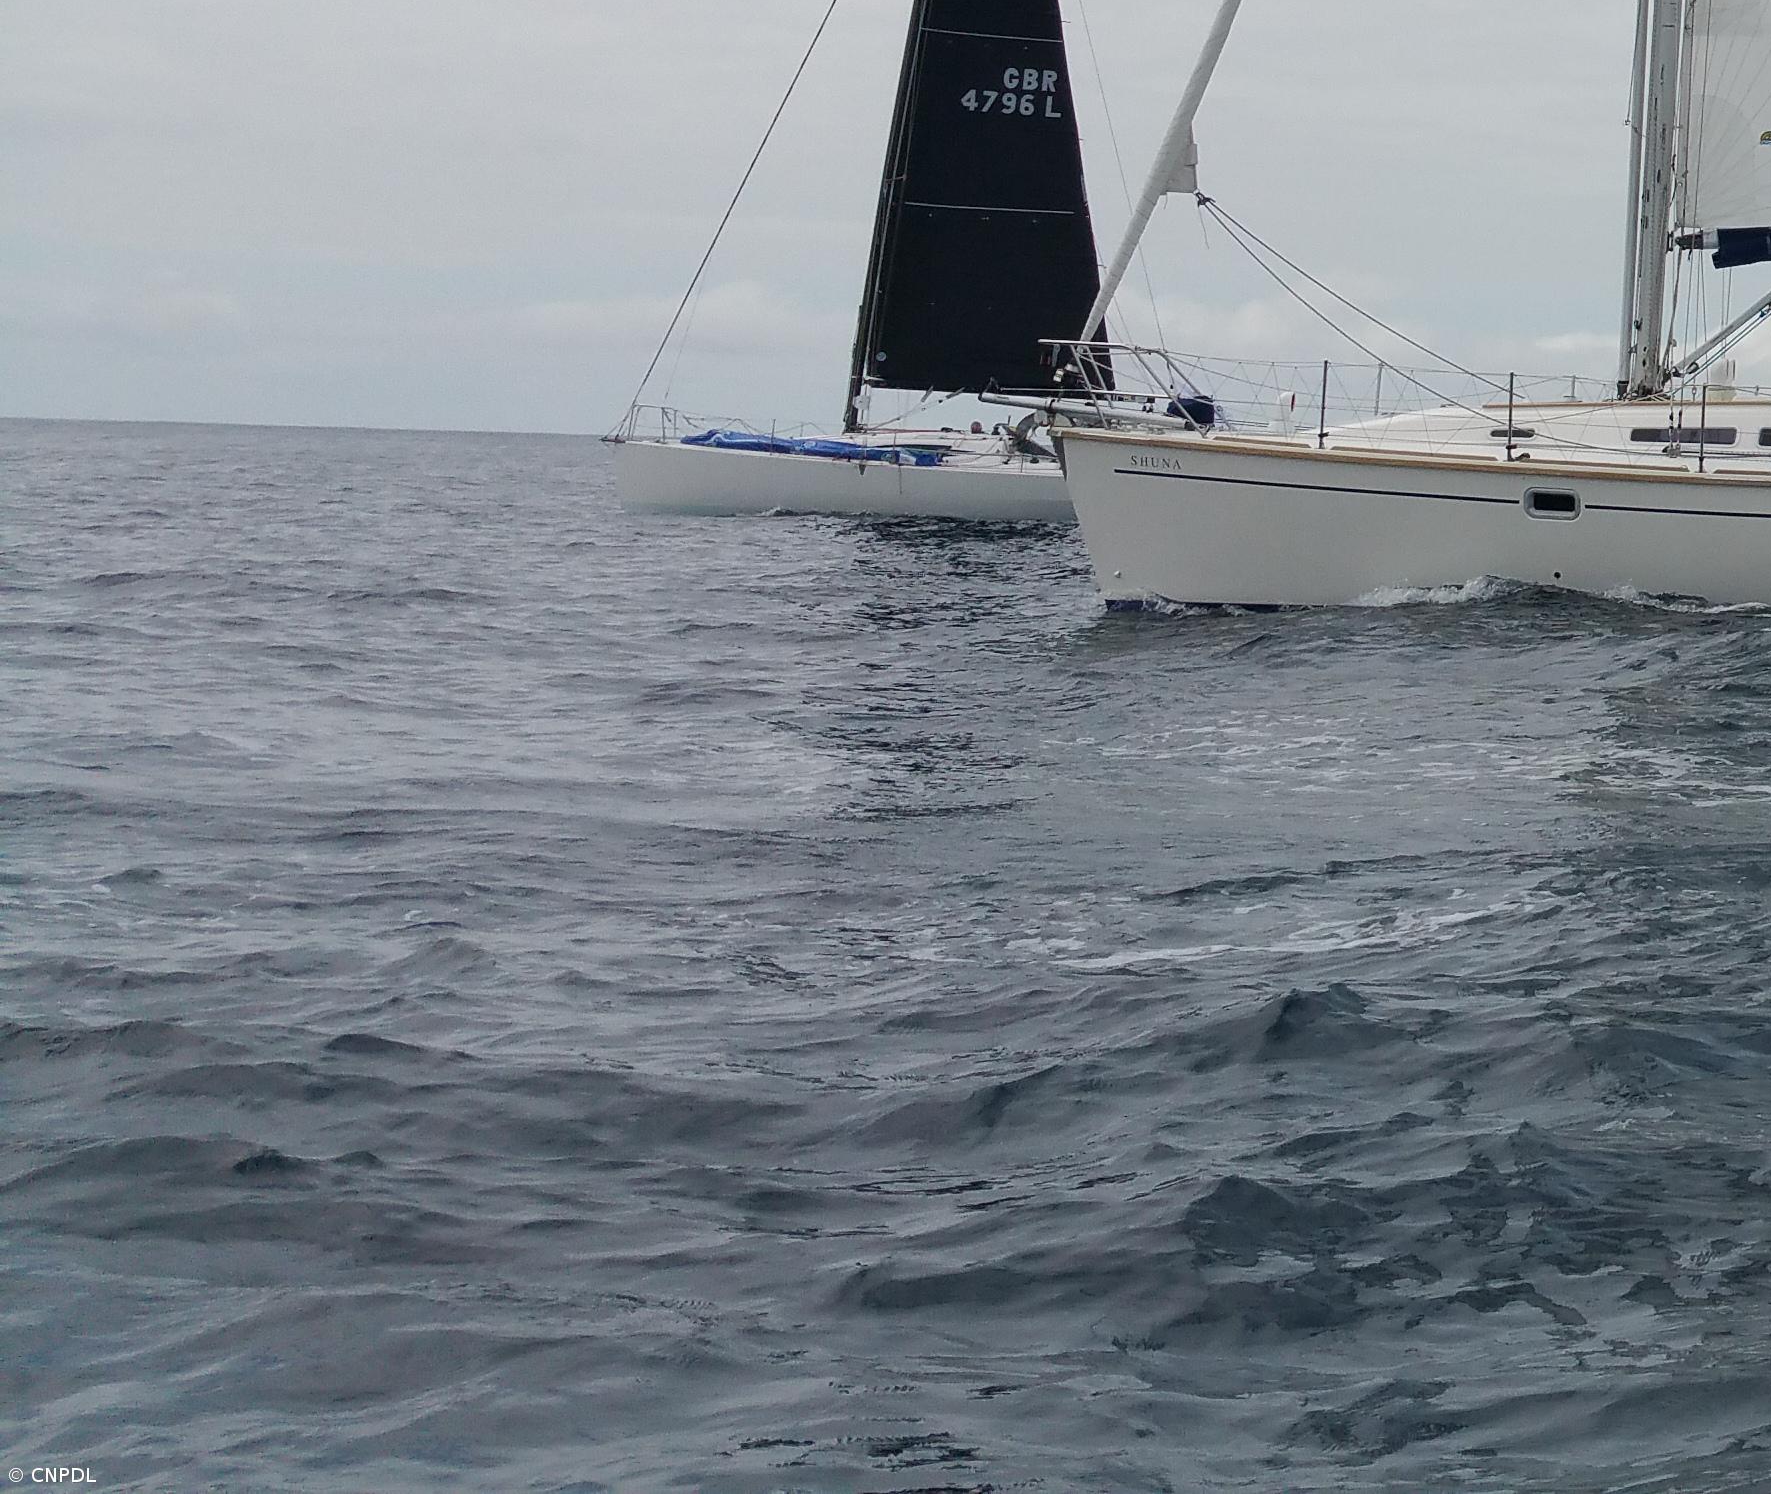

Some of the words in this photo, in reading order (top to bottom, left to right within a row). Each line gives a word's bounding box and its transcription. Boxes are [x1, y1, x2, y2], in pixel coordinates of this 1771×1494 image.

[1003, 67, 1058, 92] GBR
[960, 89, 1035, 116] 4796
[1045, 95, 1062, 118] L
[1130, 455, 1182, 470] SHUNA
